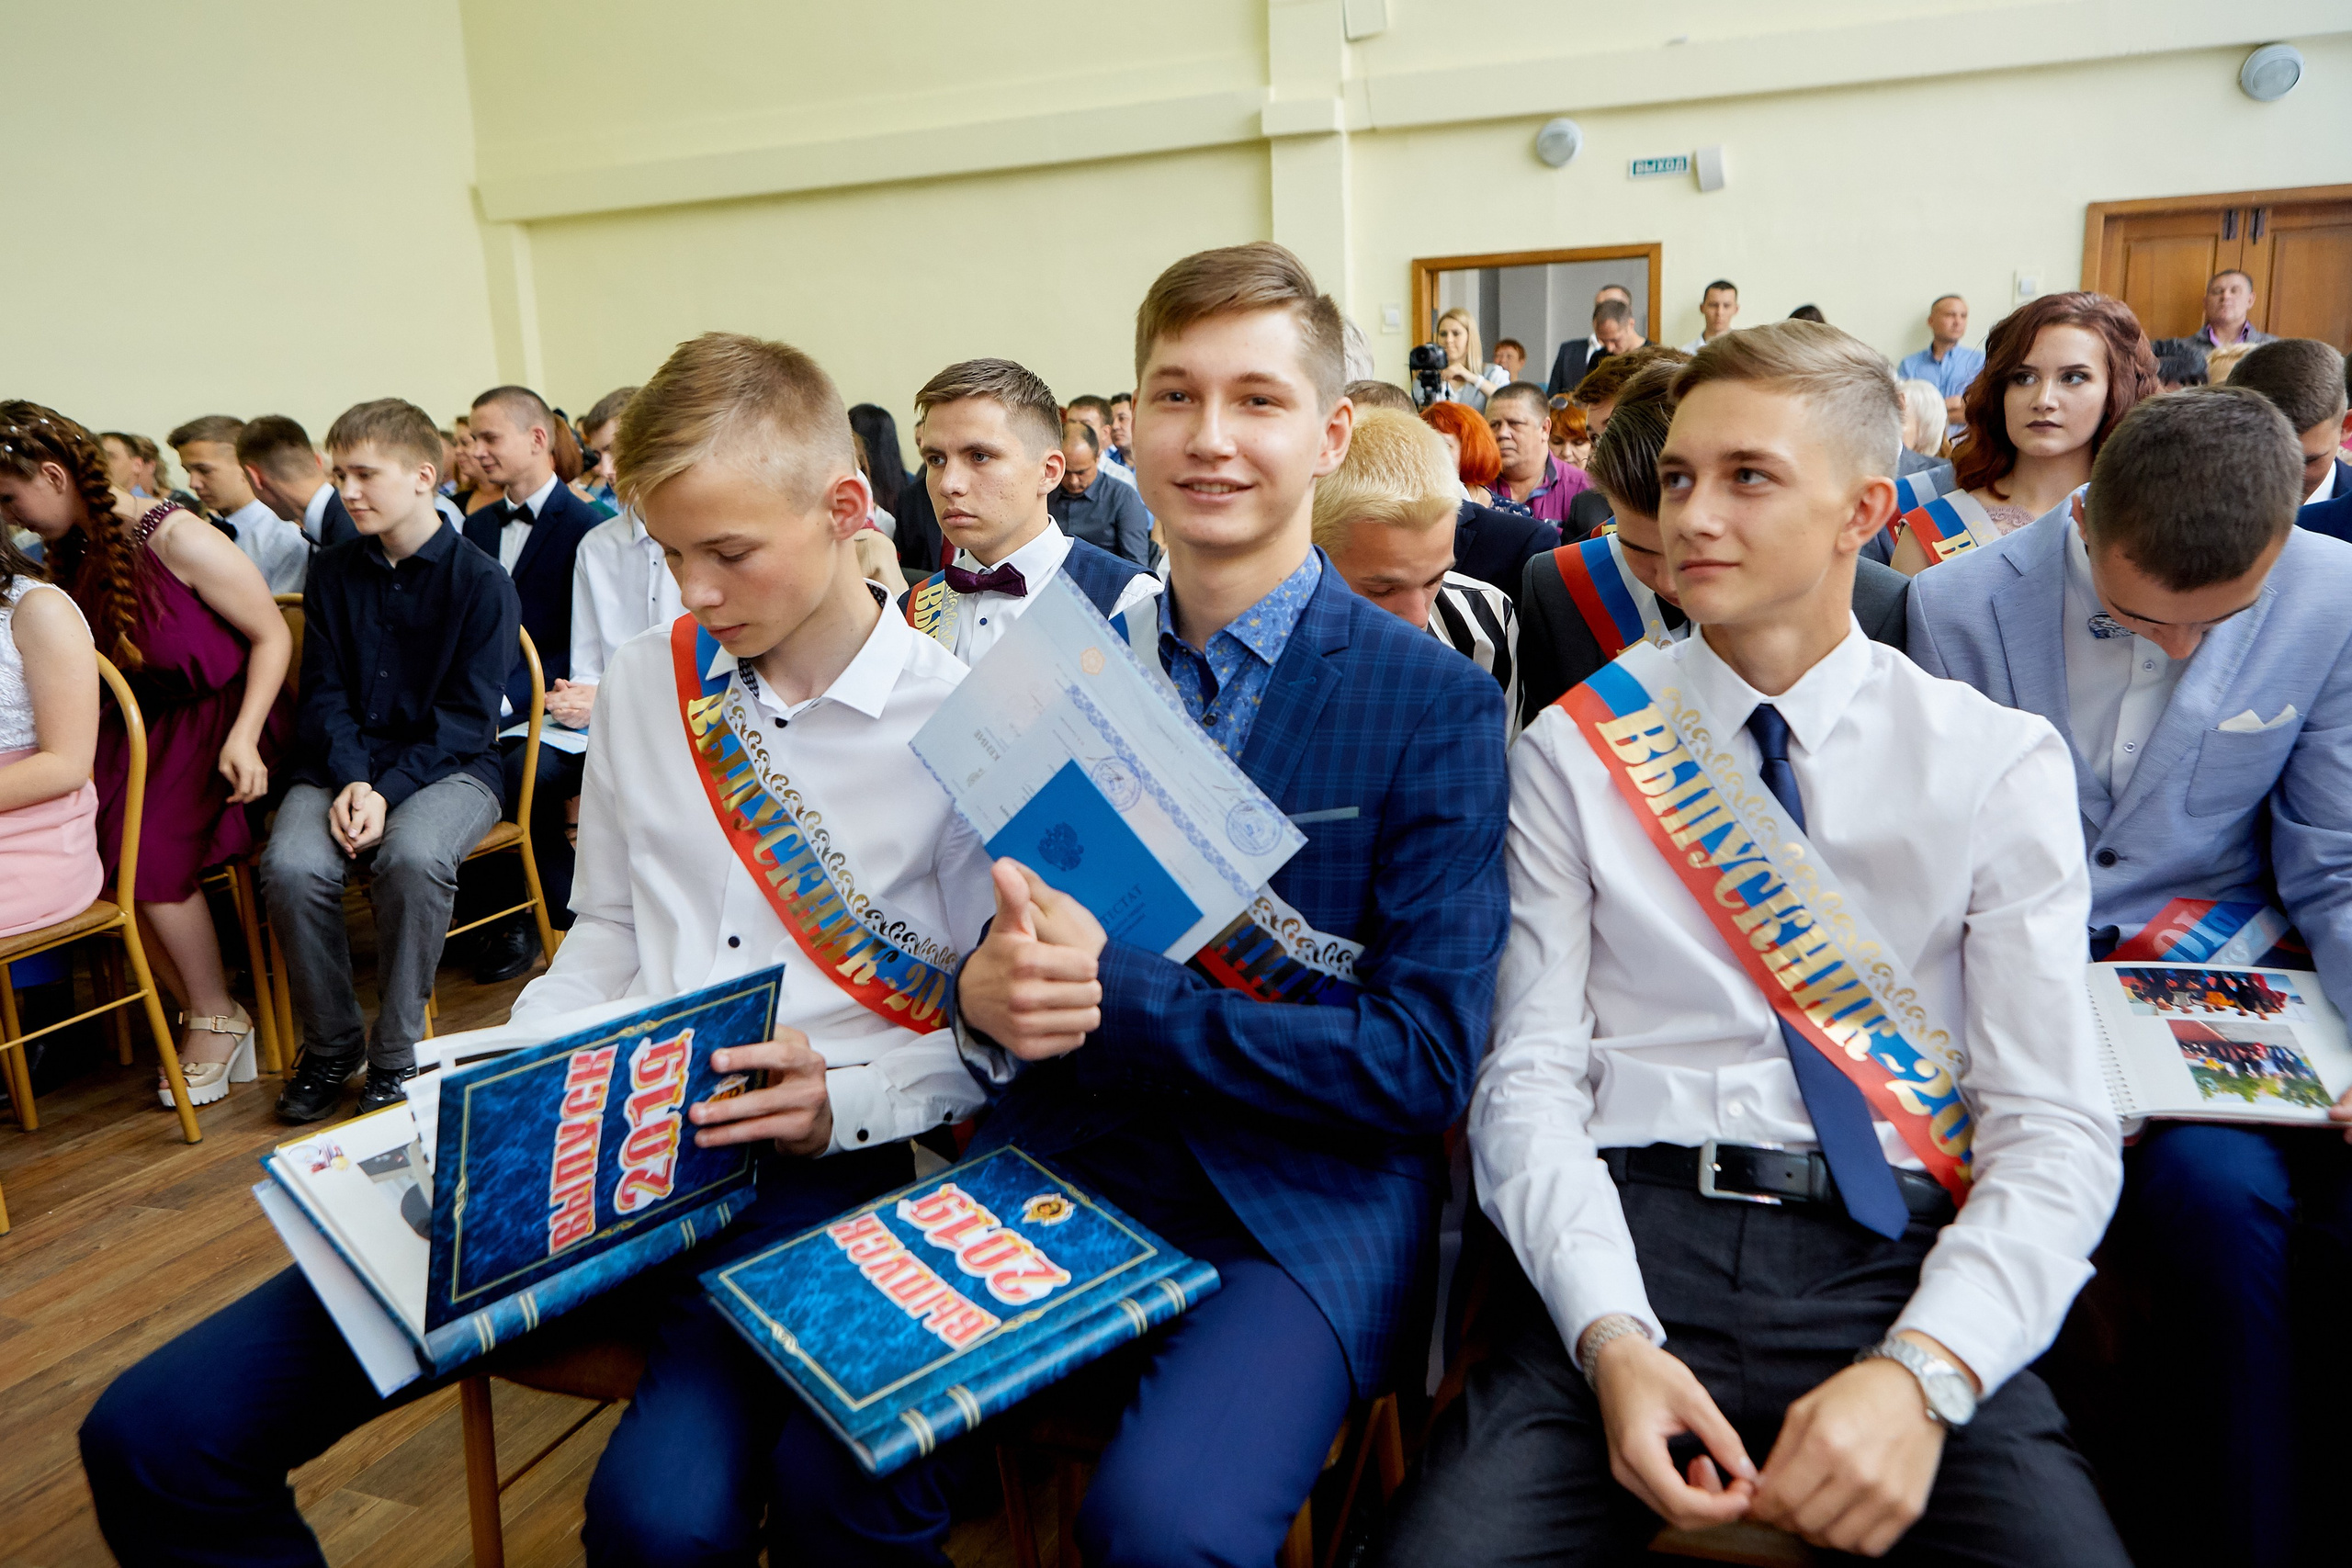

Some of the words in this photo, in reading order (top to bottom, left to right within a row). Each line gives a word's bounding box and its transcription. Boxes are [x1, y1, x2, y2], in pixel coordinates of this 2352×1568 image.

[1635, 156, 1685, 174] ВЫХОД
[914, 581, 944, 640] ВЫ
[1595, 703, 1973, 1181] ВЫПУСКНИК-20
[550, 1044, 618, 1255] ВЫПУСК
[615, 1029, 695, 1213] 2019
[829, 1213, 1001, 1350] ВЫПУСК
[898, 1184, 1070, 1304] 2019
